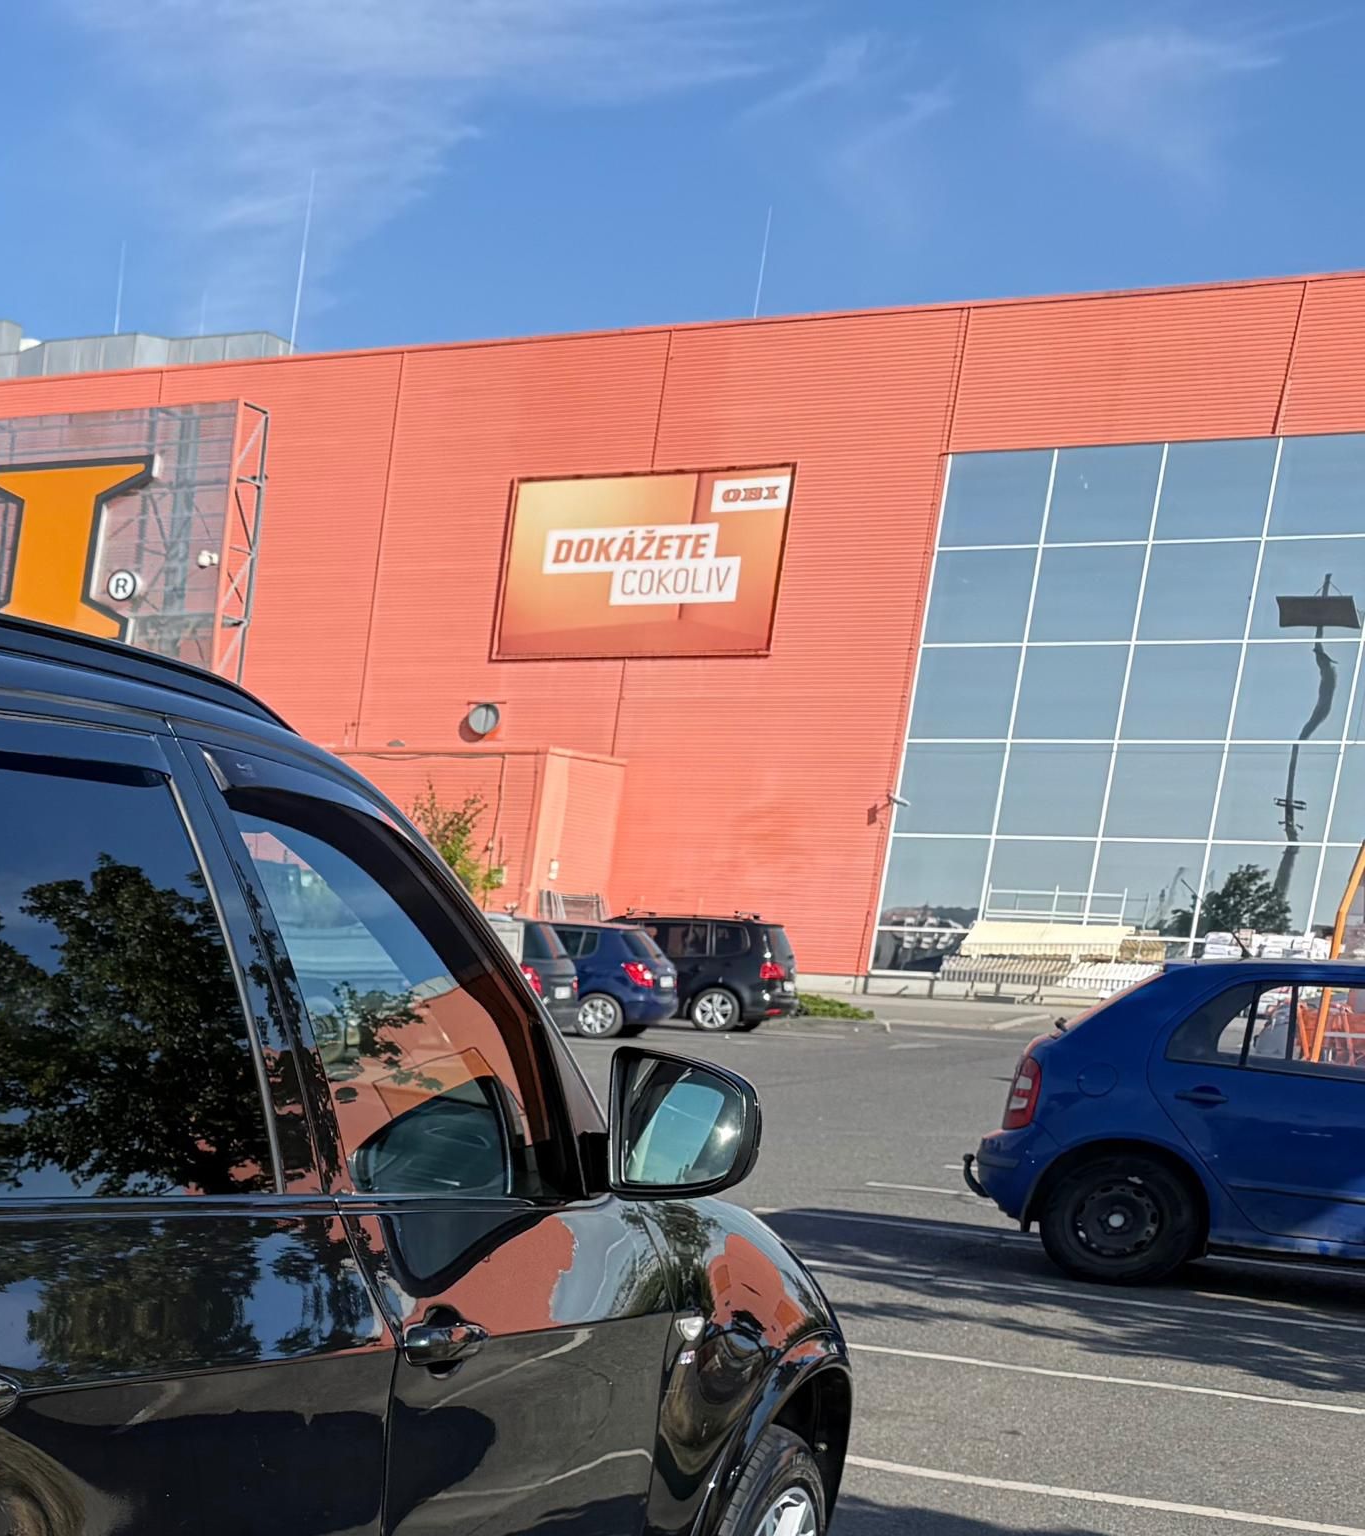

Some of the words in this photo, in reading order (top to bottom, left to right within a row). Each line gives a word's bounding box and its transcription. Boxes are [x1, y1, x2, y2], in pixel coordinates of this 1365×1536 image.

[722, 486, 781, 503] OBI
[552, 529, 710, 564] DOKÁŽETE
[621, 564, 731, 596] COKOLIV
